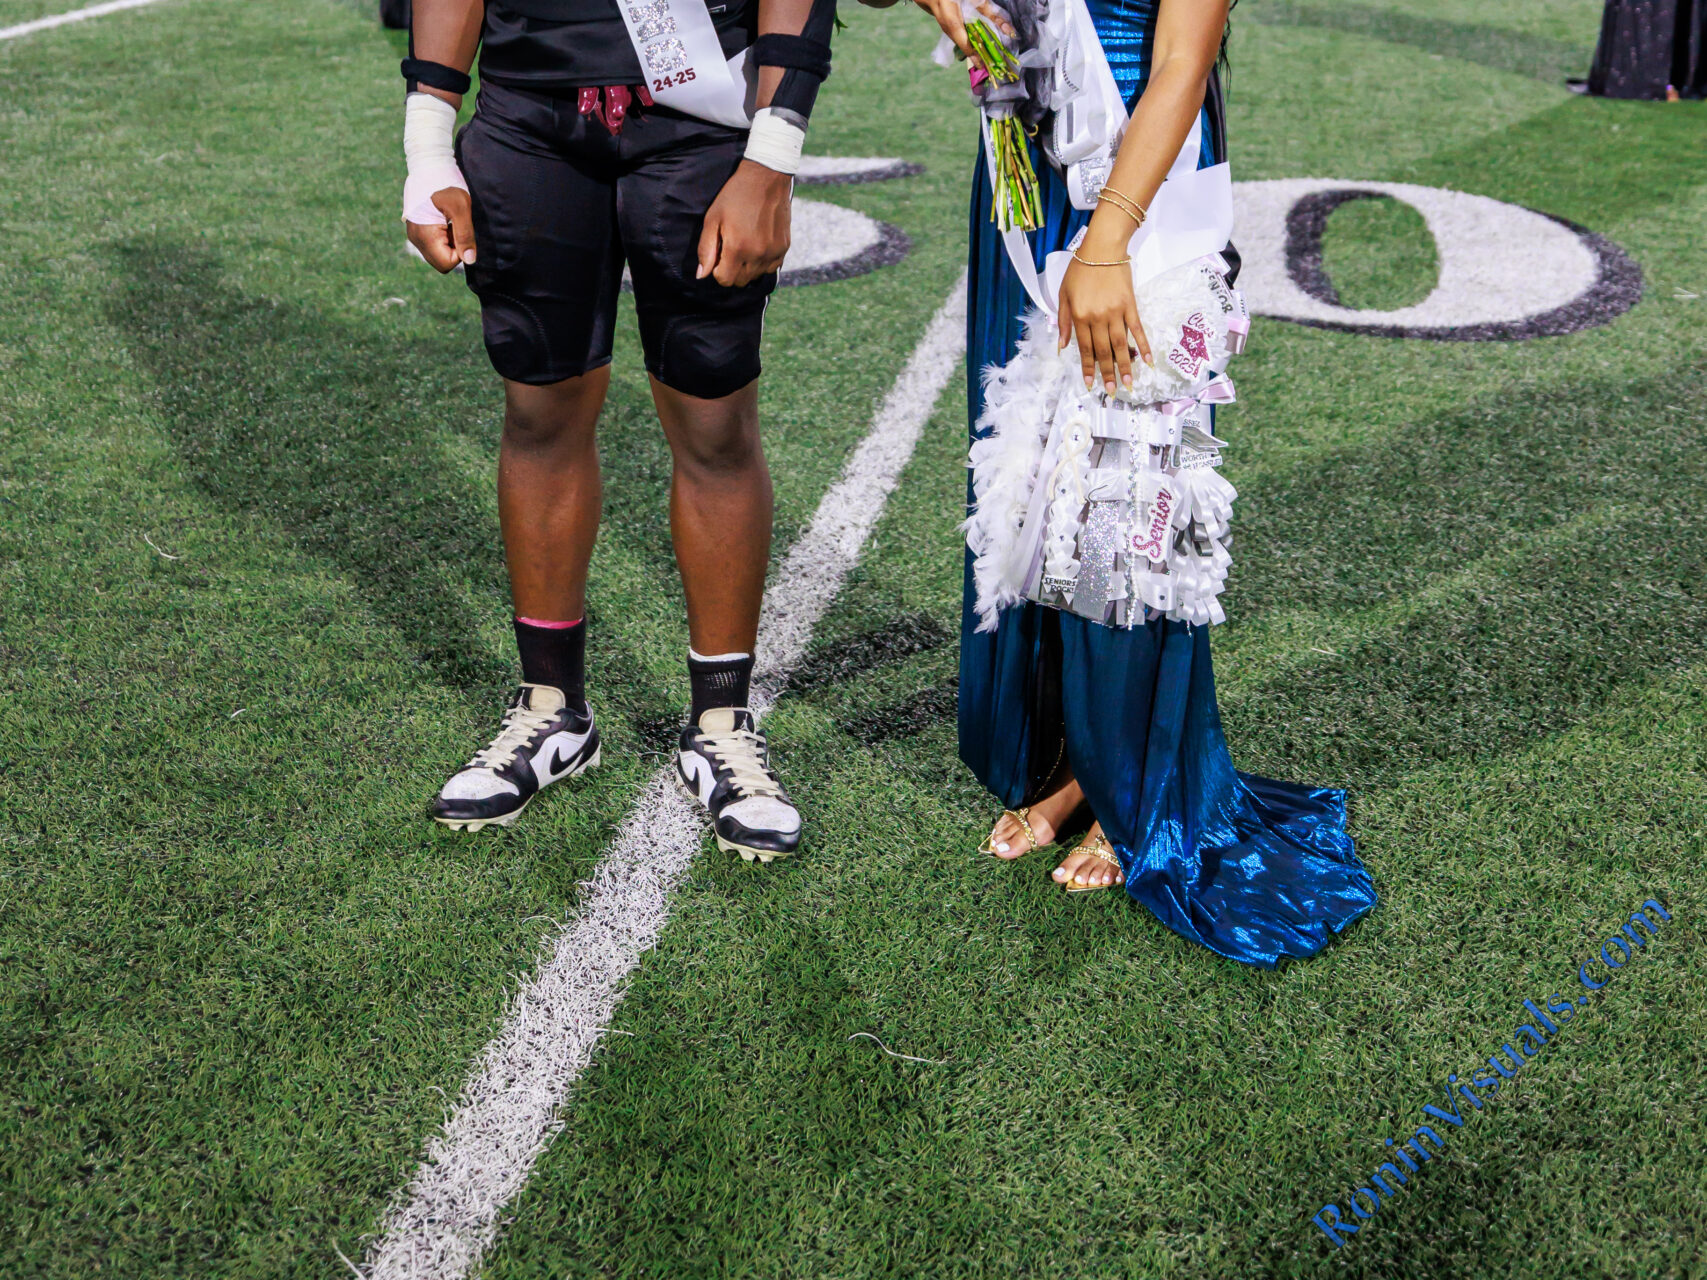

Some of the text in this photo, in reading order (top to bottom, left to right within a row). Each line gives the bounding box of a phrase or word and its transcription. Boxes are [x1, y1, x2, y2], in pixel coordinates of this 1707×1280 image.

[652, 67, 697, 92] 24-25
[1168, 349, 1196, 374] 2025
[1132, 487, 1172, 559] Senior
[1044, 576, 1077, 587] SENIORS
